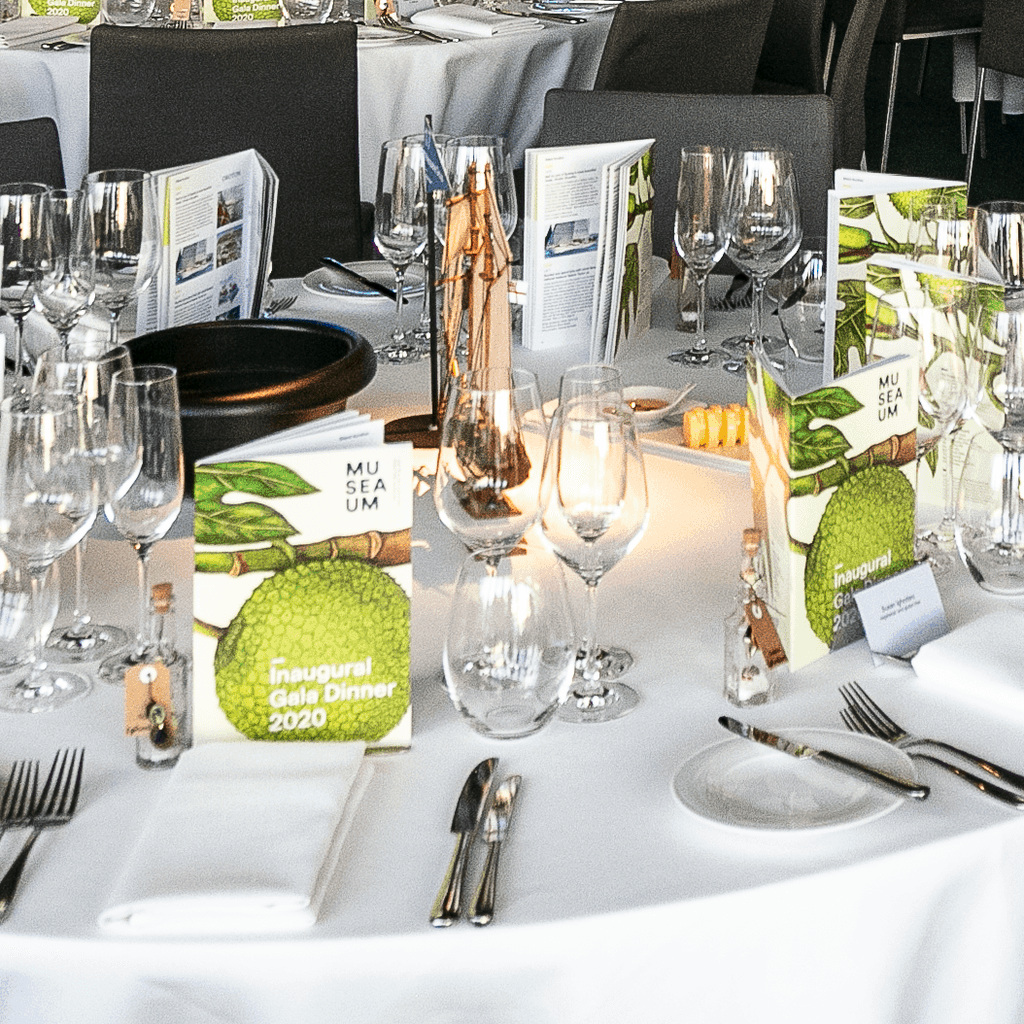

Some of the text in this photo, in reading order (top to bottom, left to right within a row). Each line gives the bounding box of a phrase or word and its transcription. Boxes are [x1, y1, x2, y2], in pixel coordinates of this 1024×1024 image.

[232, 3, 280, 13] Gala Dinner
[879, 372, 899, 390] MU
[878, 388, 903, 406] SEA
[878, 405, 898, 422] UM
[346, 461, 380, 476] MU
[346, 479, 386, 494] SEA
[346, 497, 379, 512] UM
[834, 549, 892, 589] Inaugural
[268, 657, 372, 684] Inaugural
[268, 680, 398, 709] Gala Dinner
[268, 708, 328, 733] 2020
